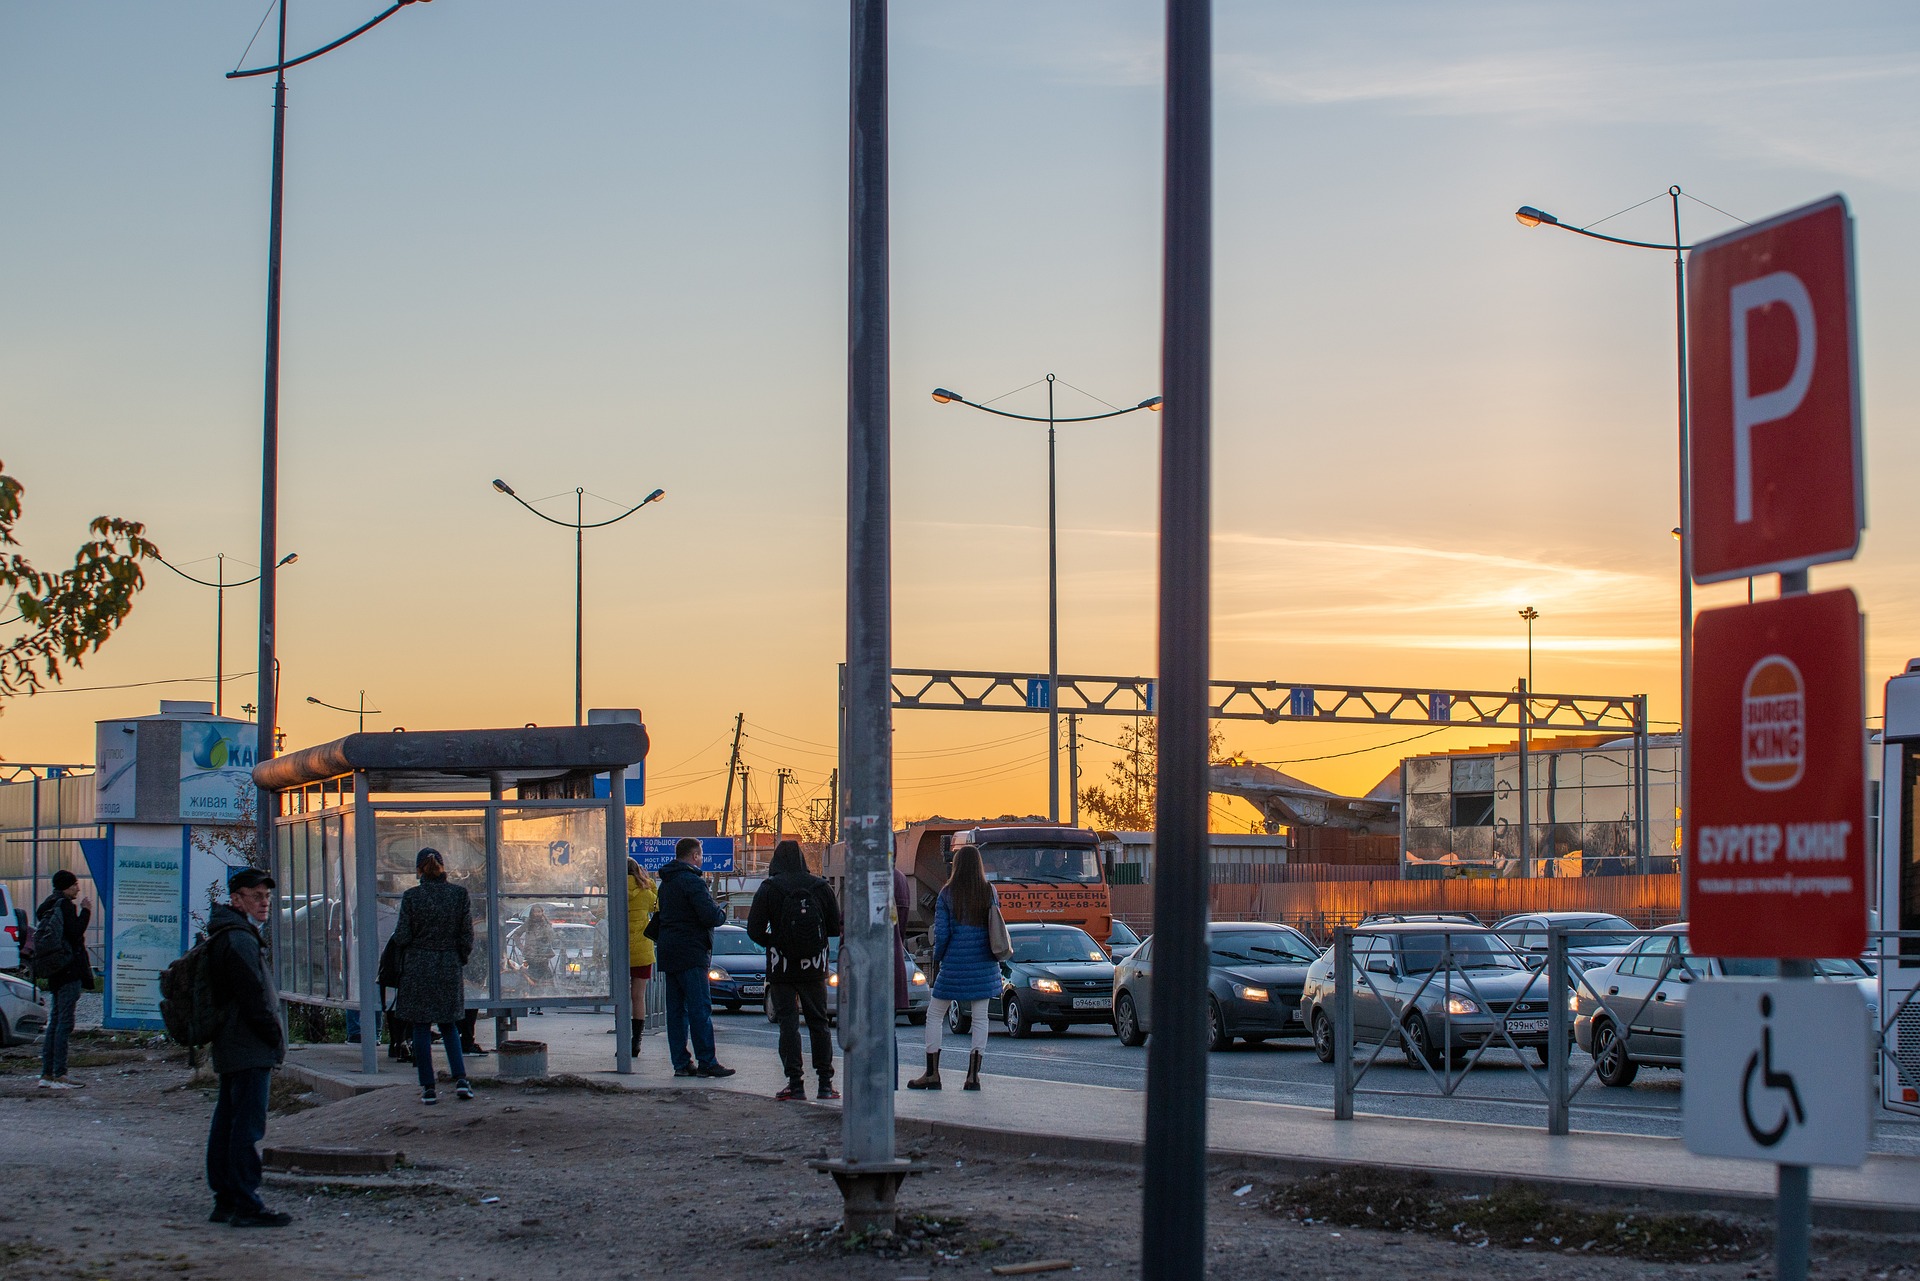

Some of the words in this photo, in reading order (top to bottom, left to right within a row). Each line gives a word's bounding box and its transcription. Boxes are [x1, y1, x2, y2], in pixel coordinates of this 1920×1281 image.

[1730, 271, 1817, 524] P
[1699, 823, 1782, 863] БУРГЕР
[1785, 821, 1851, 861] КИНГ
[119, 860, 152, 869] ЖИВАЯ
[154, 861, 179, 870] ВОДА
[998, 892, 1024, 900] ТОН,
[1028, 892, 1053, 900] ПГС,
[1056, 892, 1107, 900] ЩЕБЕНЬ
[1508, 1021, 1534, 1030] 299НК
